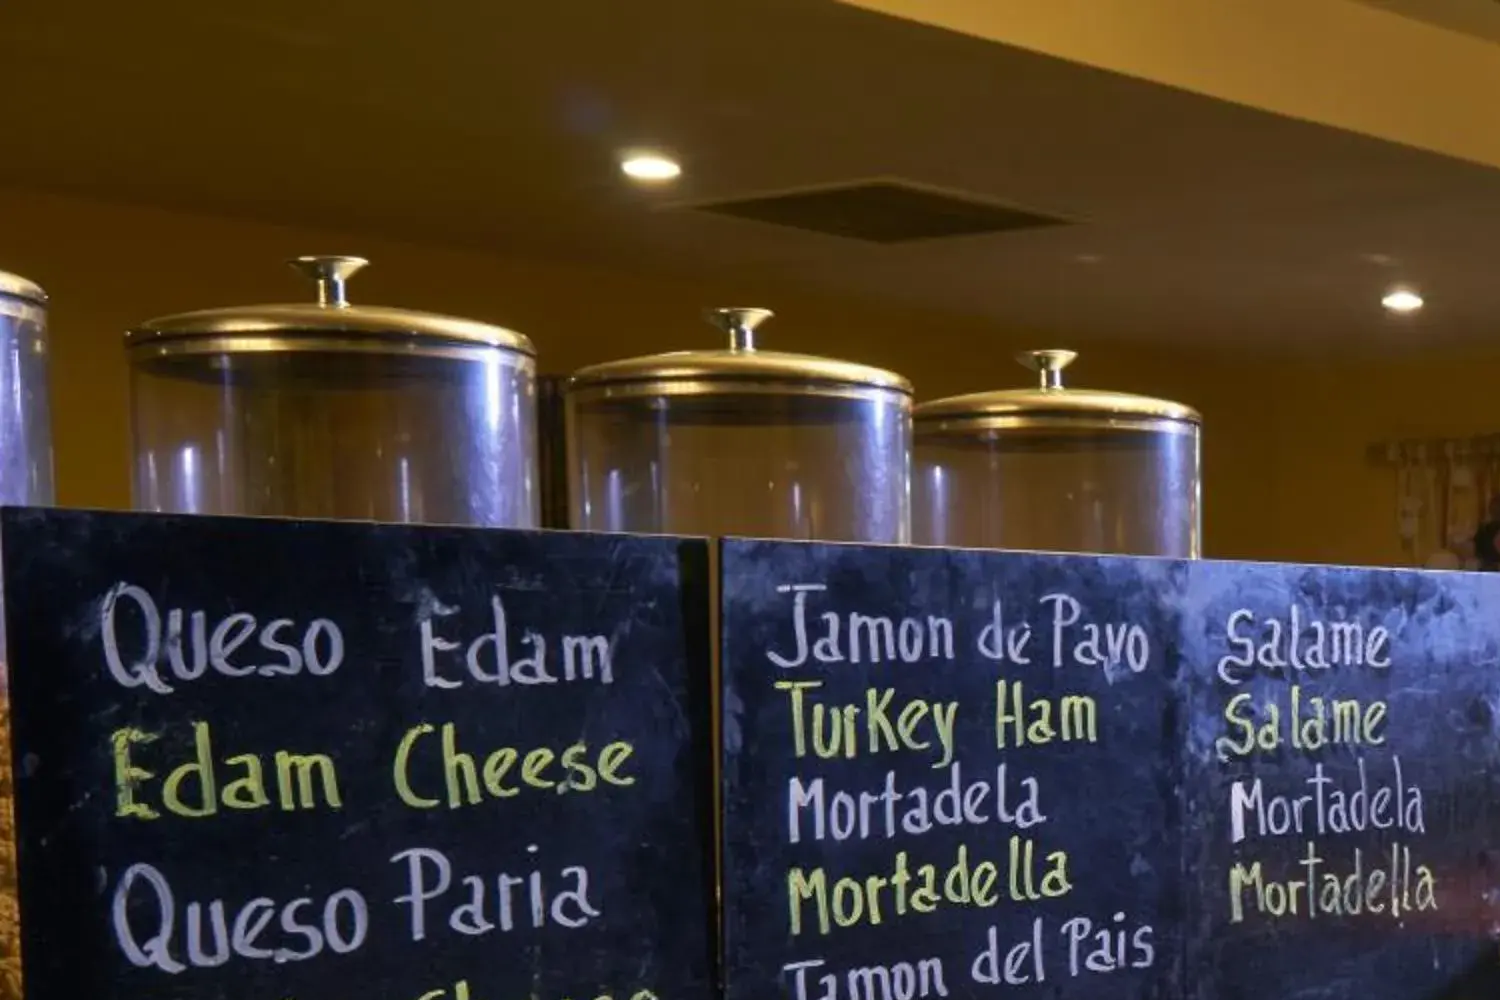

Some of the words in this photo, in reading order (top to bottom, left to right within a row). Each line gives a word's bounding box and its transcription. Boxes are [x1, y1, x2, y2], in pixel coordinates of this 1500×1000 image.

[101, 581, 345, 693] Queso
[418, 595, 614, 688] Edam
[766, 584, 955, 668] Jamon
[977, 600, 1032, 664] de
[1217, 603, 1392, 685] Salame
[996, 679, 1097, 749] Ham
[1215, 685, 1388, 763] Salame
[110, 721, 342, 819] Edam
[394, 722, 635, 809] Cheese
[788, 761, 1047, 843] Mortadela
[1231, 754, 1426, 844] Mortadela
[113, 862, 368, 973] Queso
[390, 845, 600, 941] Paria
[787, 835, 1073, 936] Mortadella
[1229, 841, 1438, 924] Mortadella
[971, 917, 1045, 985] del
